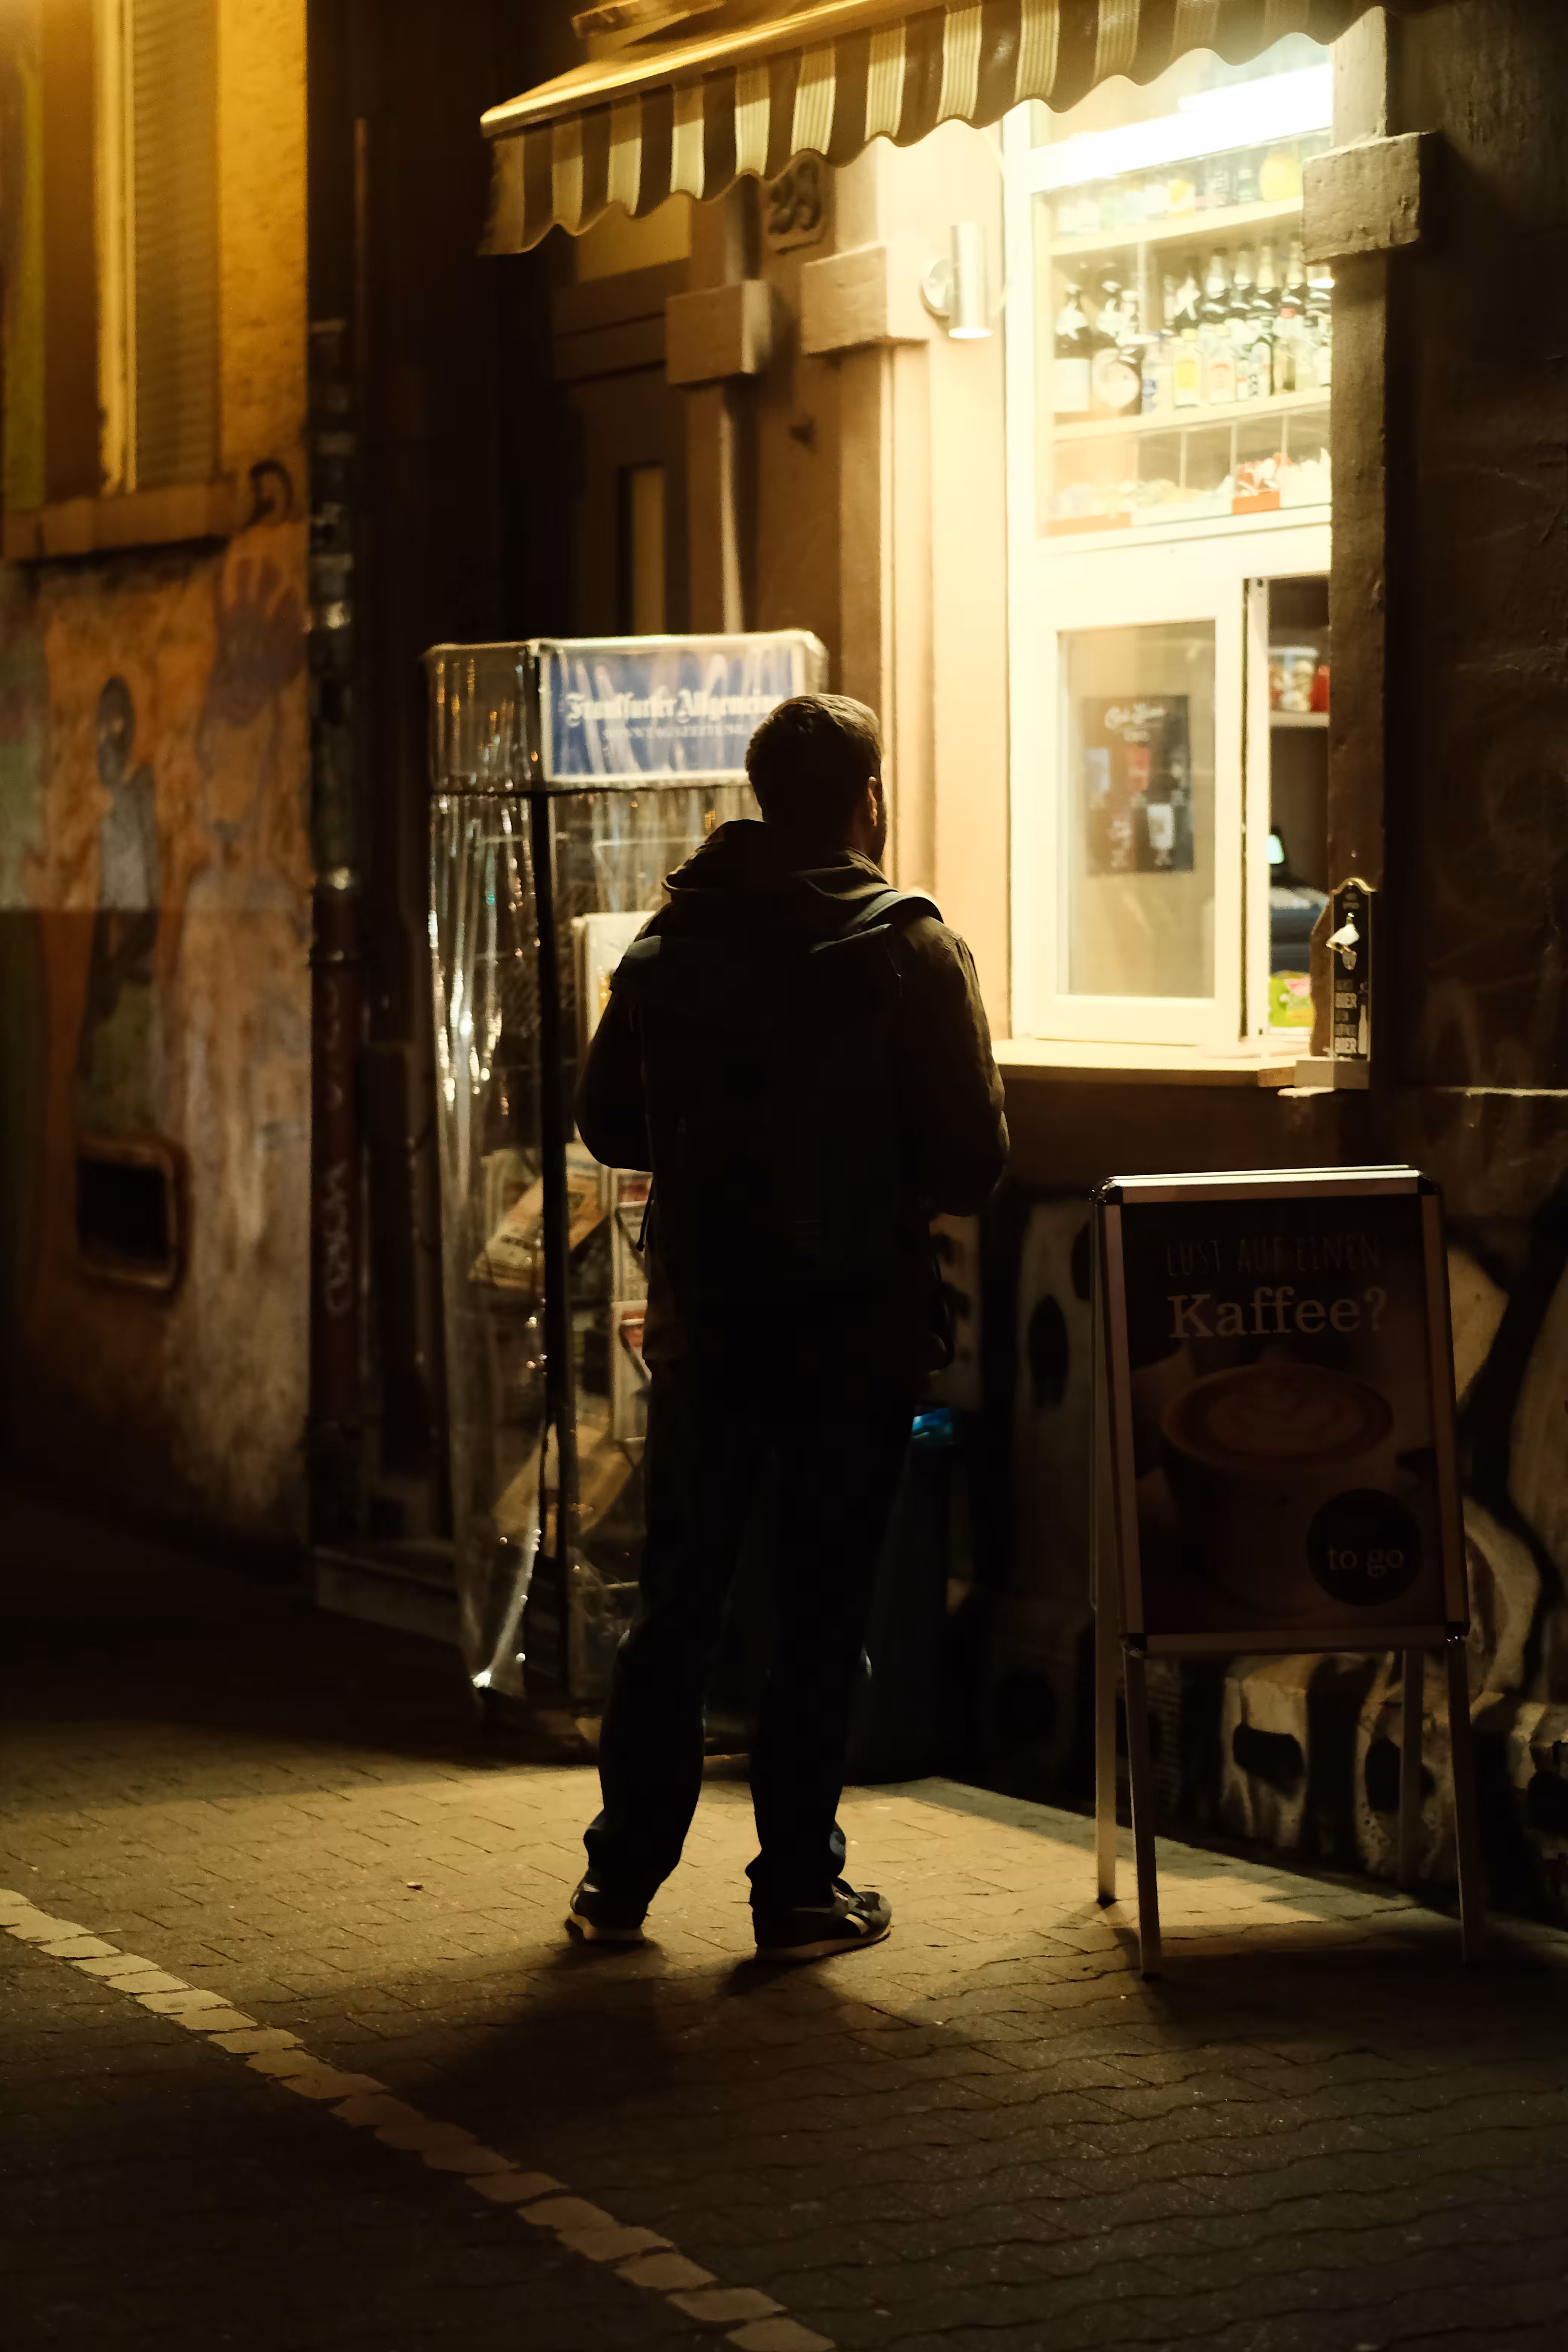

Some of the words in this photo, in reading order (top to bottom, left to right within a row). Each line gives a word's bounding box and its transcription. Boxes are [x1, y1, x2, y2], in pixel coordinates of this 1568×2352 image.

[1167, 1238, 1222, 1276] LUST
[1237, 1237, 1286, 1274] AUF
[1295, 1231, 1380, 1272] EINEN
[1167, 1286, 1387, 1338] Kaffee?
[1327, 1544, 1357, 1570] to
[1366, 1549, 1404, 1577] go
